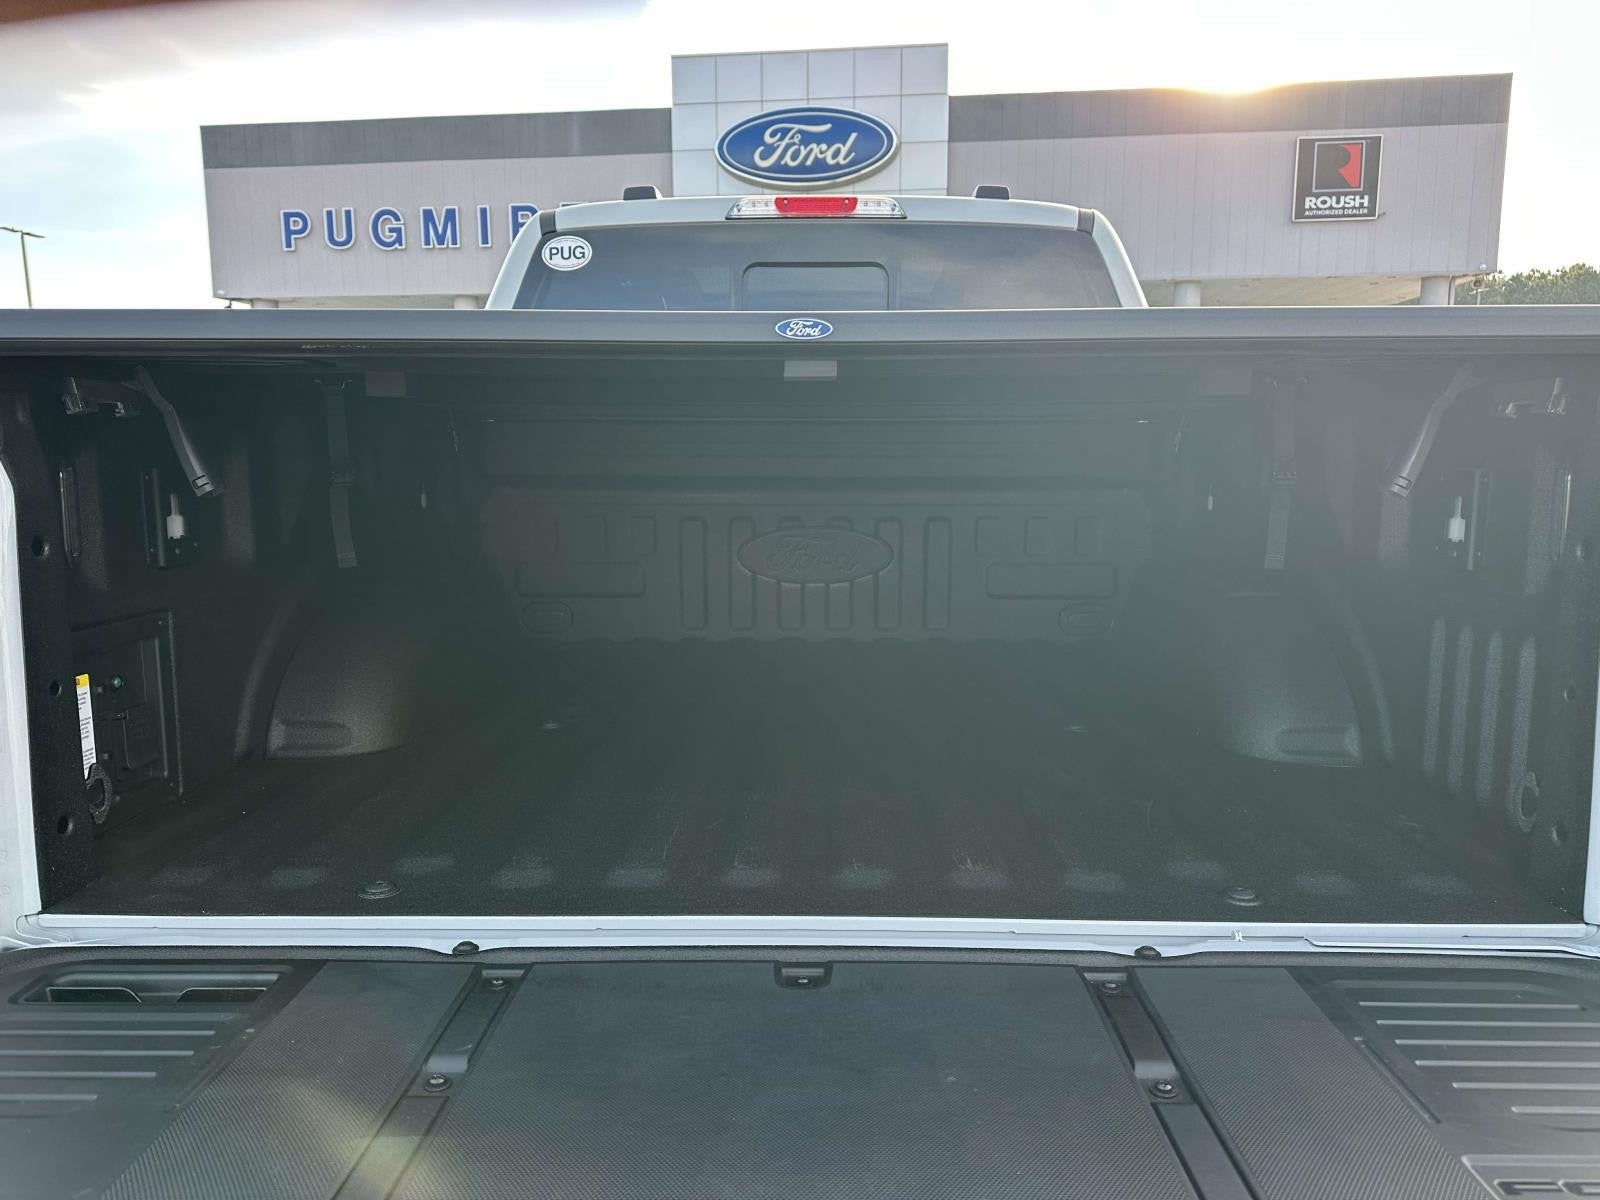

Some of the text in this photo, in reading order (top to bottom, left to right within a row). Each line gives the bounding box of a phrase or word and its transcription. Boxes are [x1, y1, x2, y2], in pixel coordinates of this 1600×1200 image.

[753, 123, 858, 168] Ford
[1304, 195, 1369, 209] ROUSH
[1304, 208, 1343, 216] AUTHORIZED
[280, 202, 581, 251] PUGMIR
[549, 245, 585, 260] PUG
[786, 320, 822, 336] Ford
[767, 534, 859, 573] Ford
